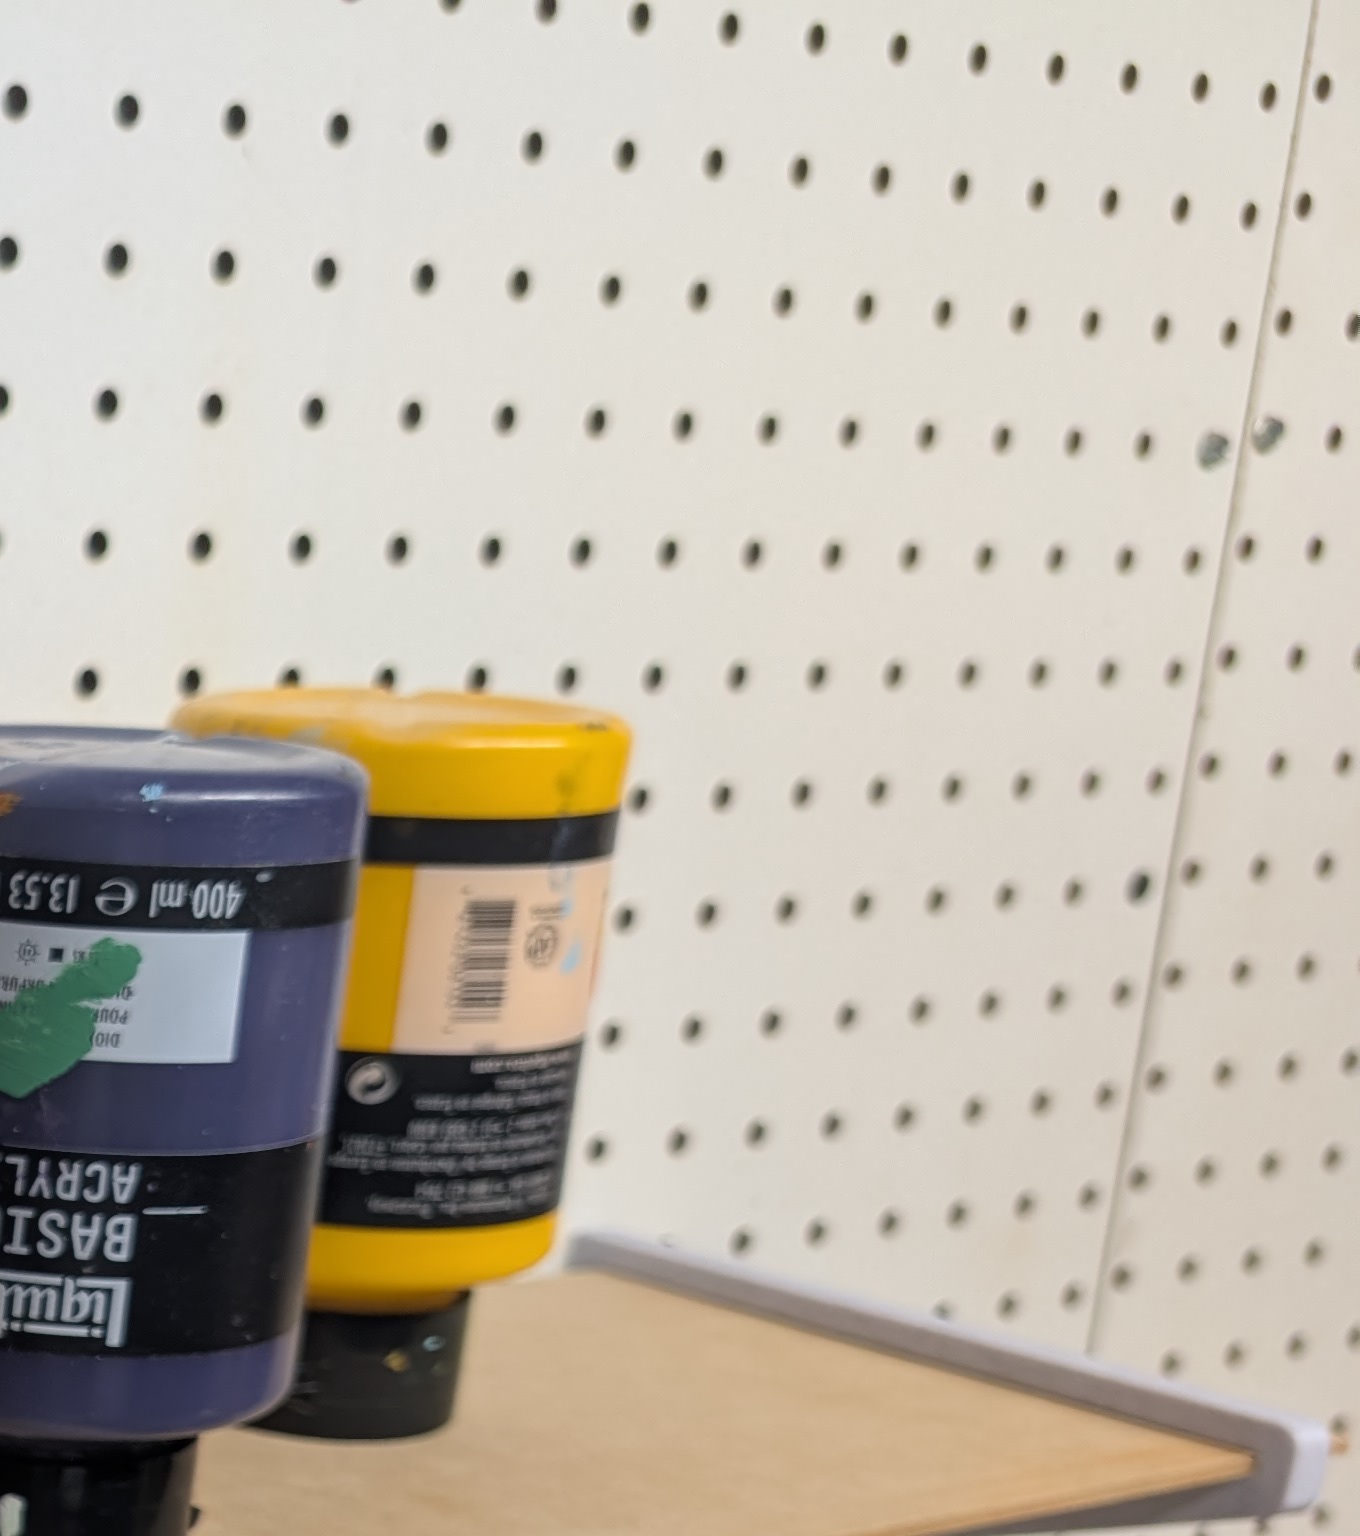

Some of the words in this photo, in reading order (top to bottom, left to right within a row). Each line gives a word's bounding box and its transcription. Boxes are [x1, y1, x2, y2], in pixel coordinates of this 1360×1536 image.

[8, 871, 80, 914] 13.53
[149, 879, 189, 918] ml
[192, 878, 246, 919] 400
